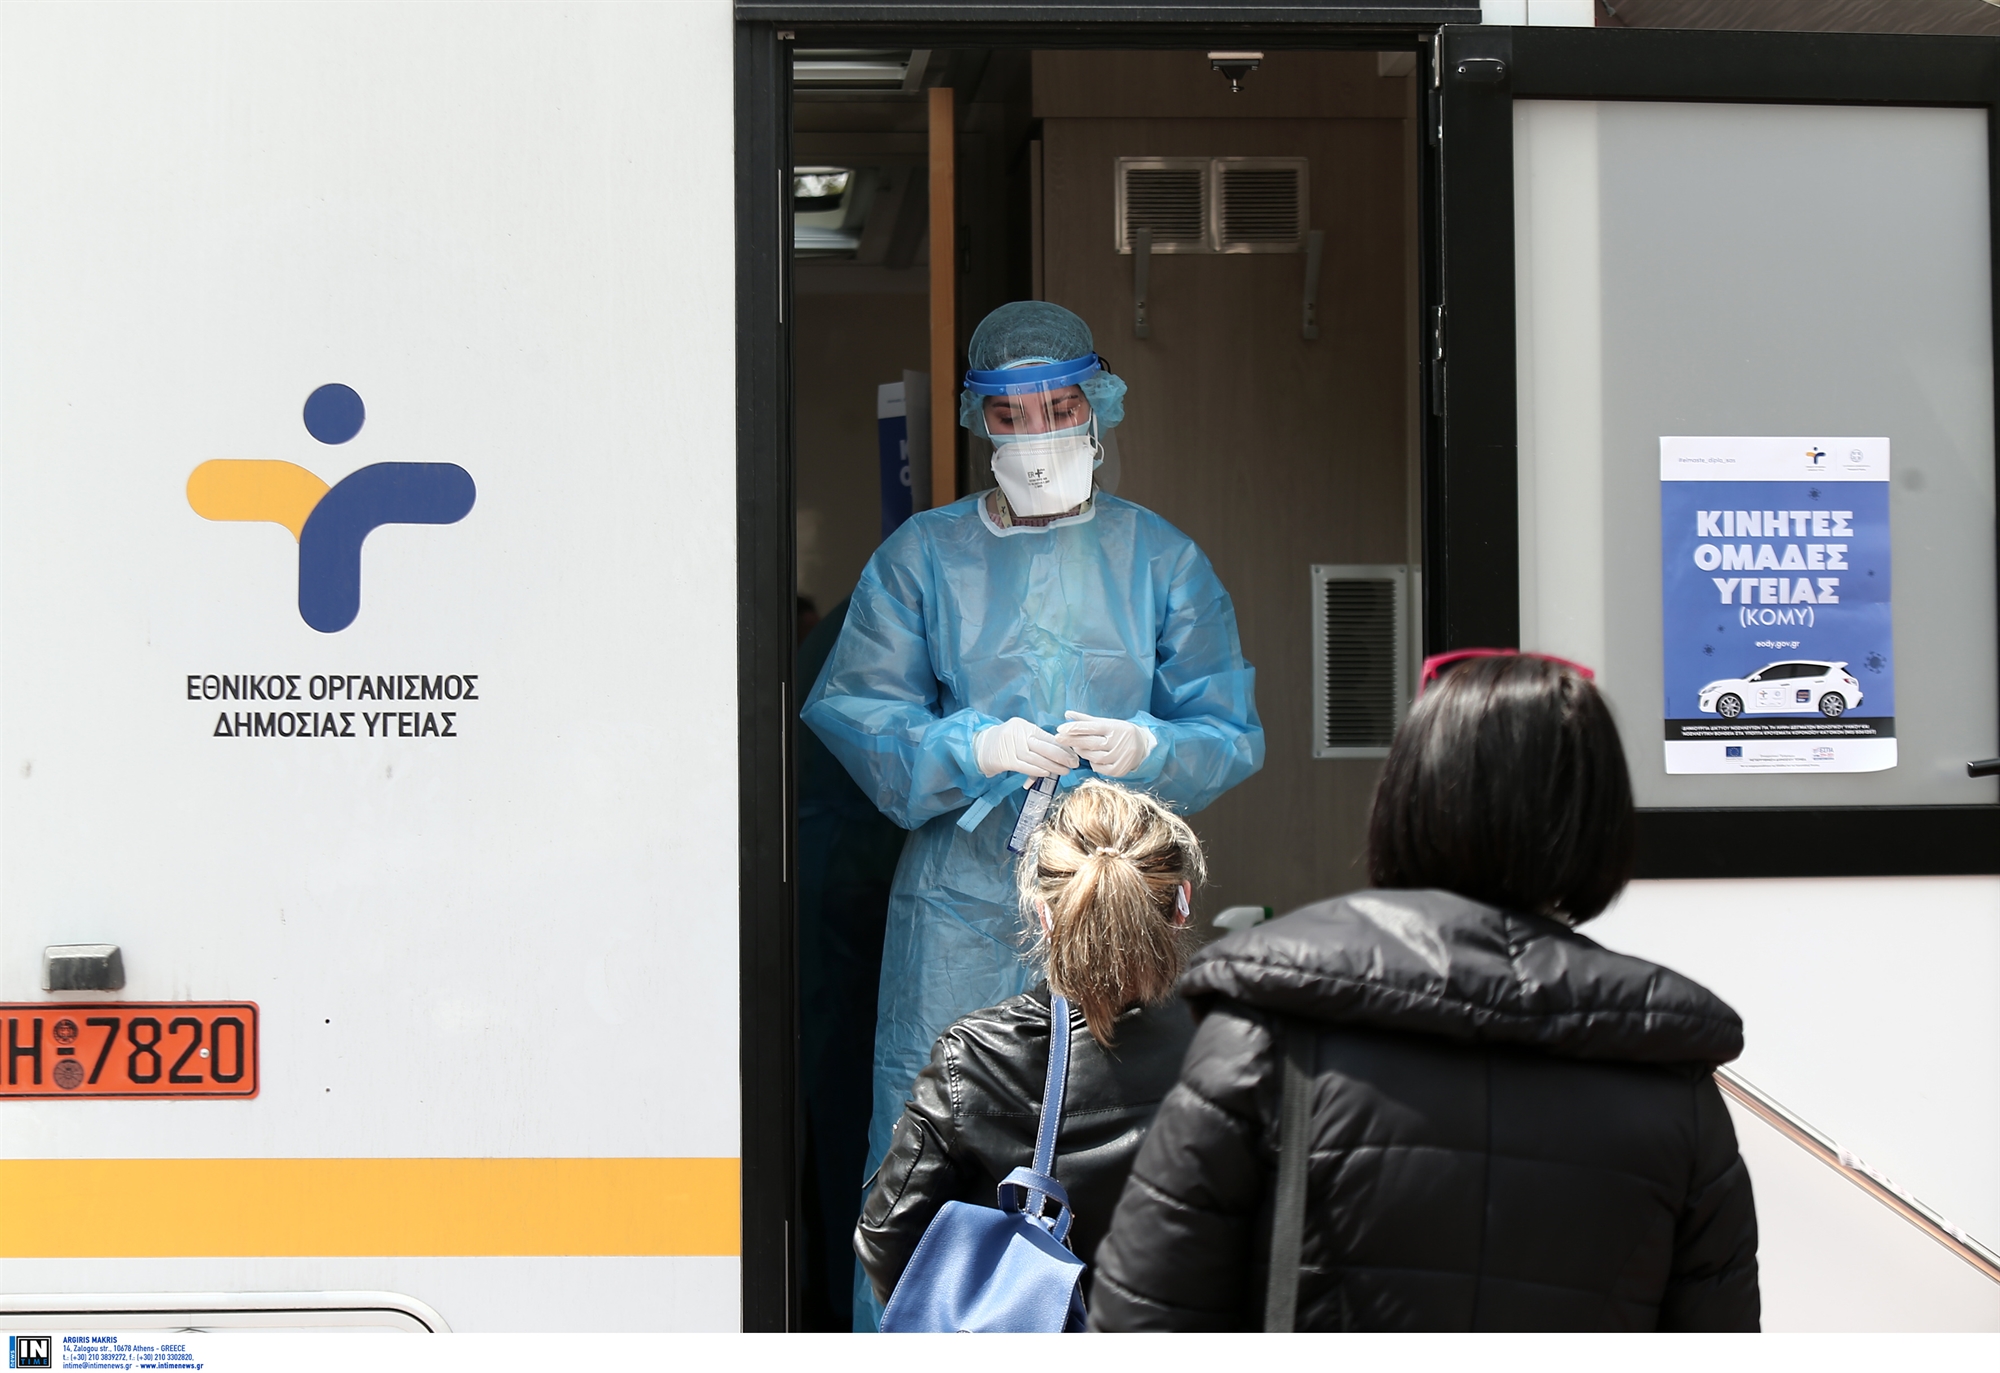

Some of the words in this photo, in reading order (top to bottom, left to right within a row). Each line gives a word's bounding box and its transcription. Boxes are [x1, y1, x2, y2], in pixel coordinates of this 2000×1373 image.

[1697, 510, 1854, 537] ΚΙΝΗΤΕΣ
[1693, 543, 1849, 571] ΟΜΑΔΕΣ
[1712, 577, 1840, 605] ΥΓΕΙΑΣ
[1739, 606, 1815, 628] (ΚΟΜΥ)
[1754, 639, 1801, 650] eody.gov.gr
[187, 674, 302, 701] ΕΘΝΙΚΟΣ
[309, 674, 479, 701] ΟΡΓΑΝΙΣΜΟΣ
[212, 711, 356, 738] ΔΗΜΟΣΙΑΣ
[363, 711, 457, 738] ΥΓΕΙΑΣ
[0, 1016, 245, 1085] H-7820
